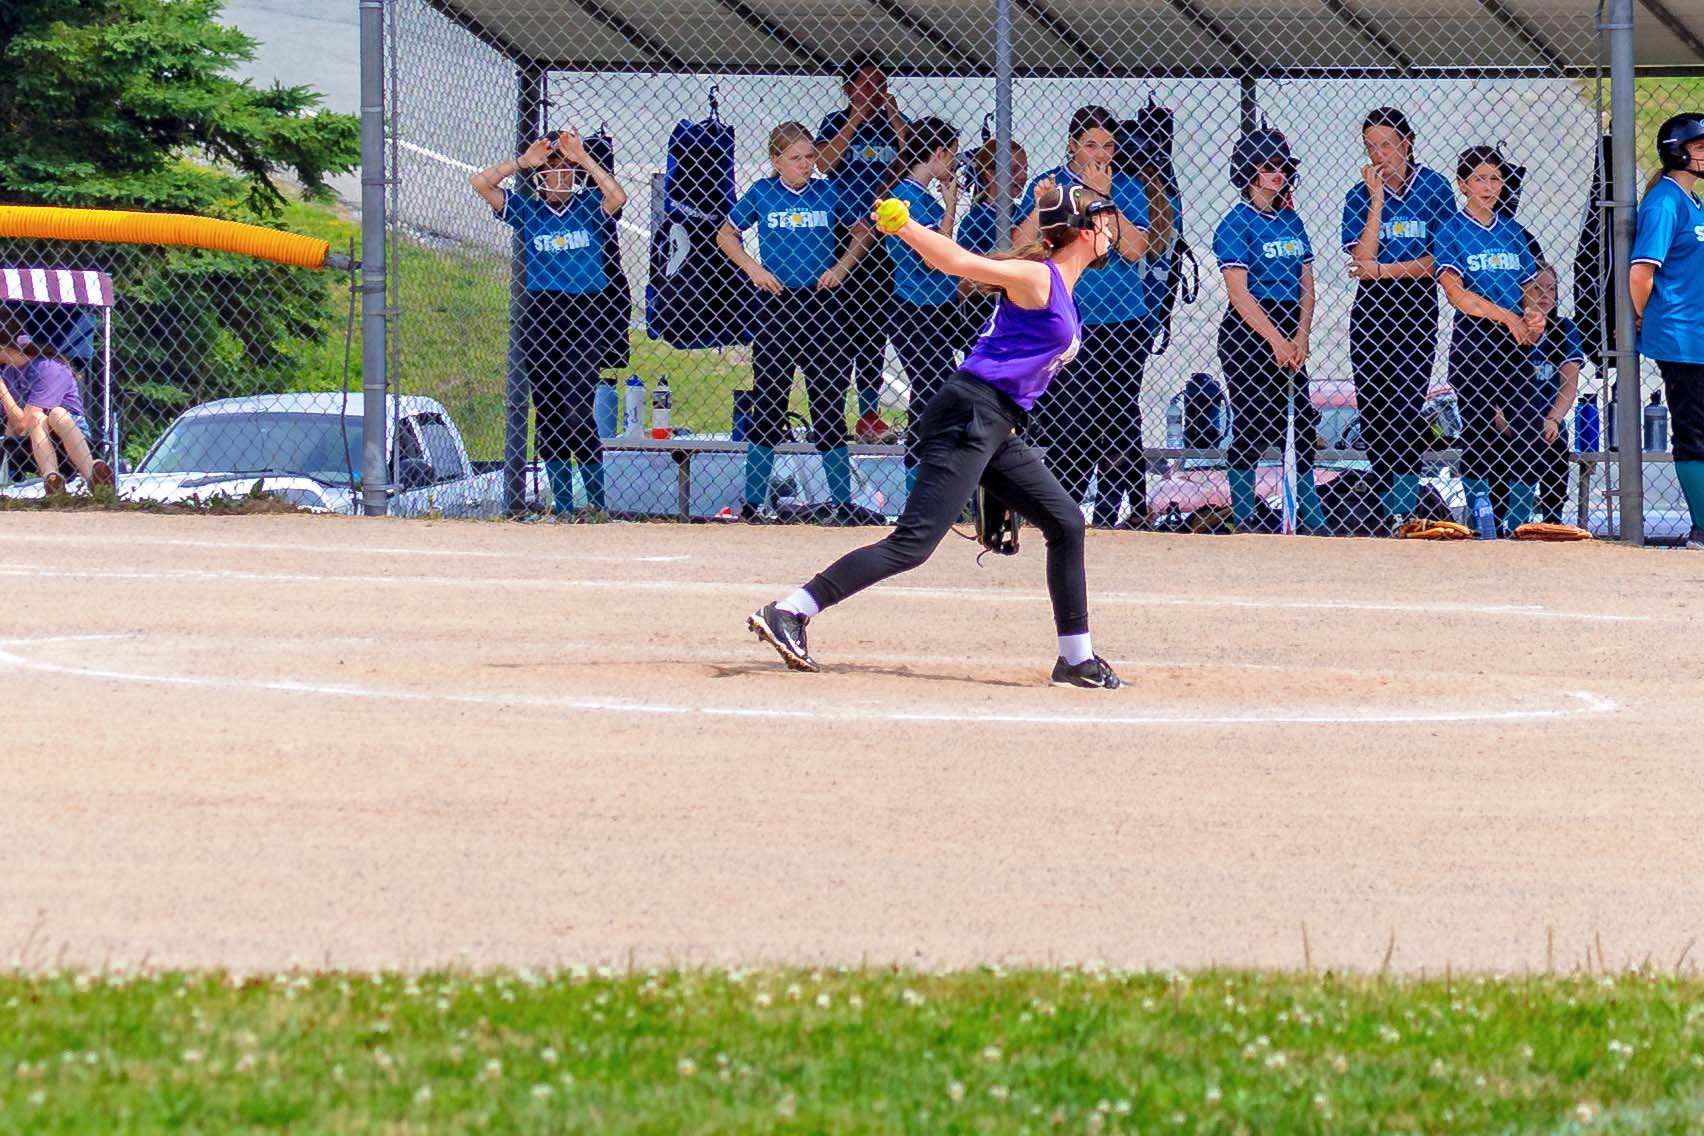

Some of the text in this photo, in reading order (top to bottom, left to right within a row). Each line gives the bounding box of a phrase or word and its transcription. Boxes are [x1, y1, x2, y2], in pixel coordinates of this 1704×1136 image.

[767, 210, 829, 229] STORM
[533, 229, 591, 252] STORM
[1466, 252, 1520, 272] STORM
